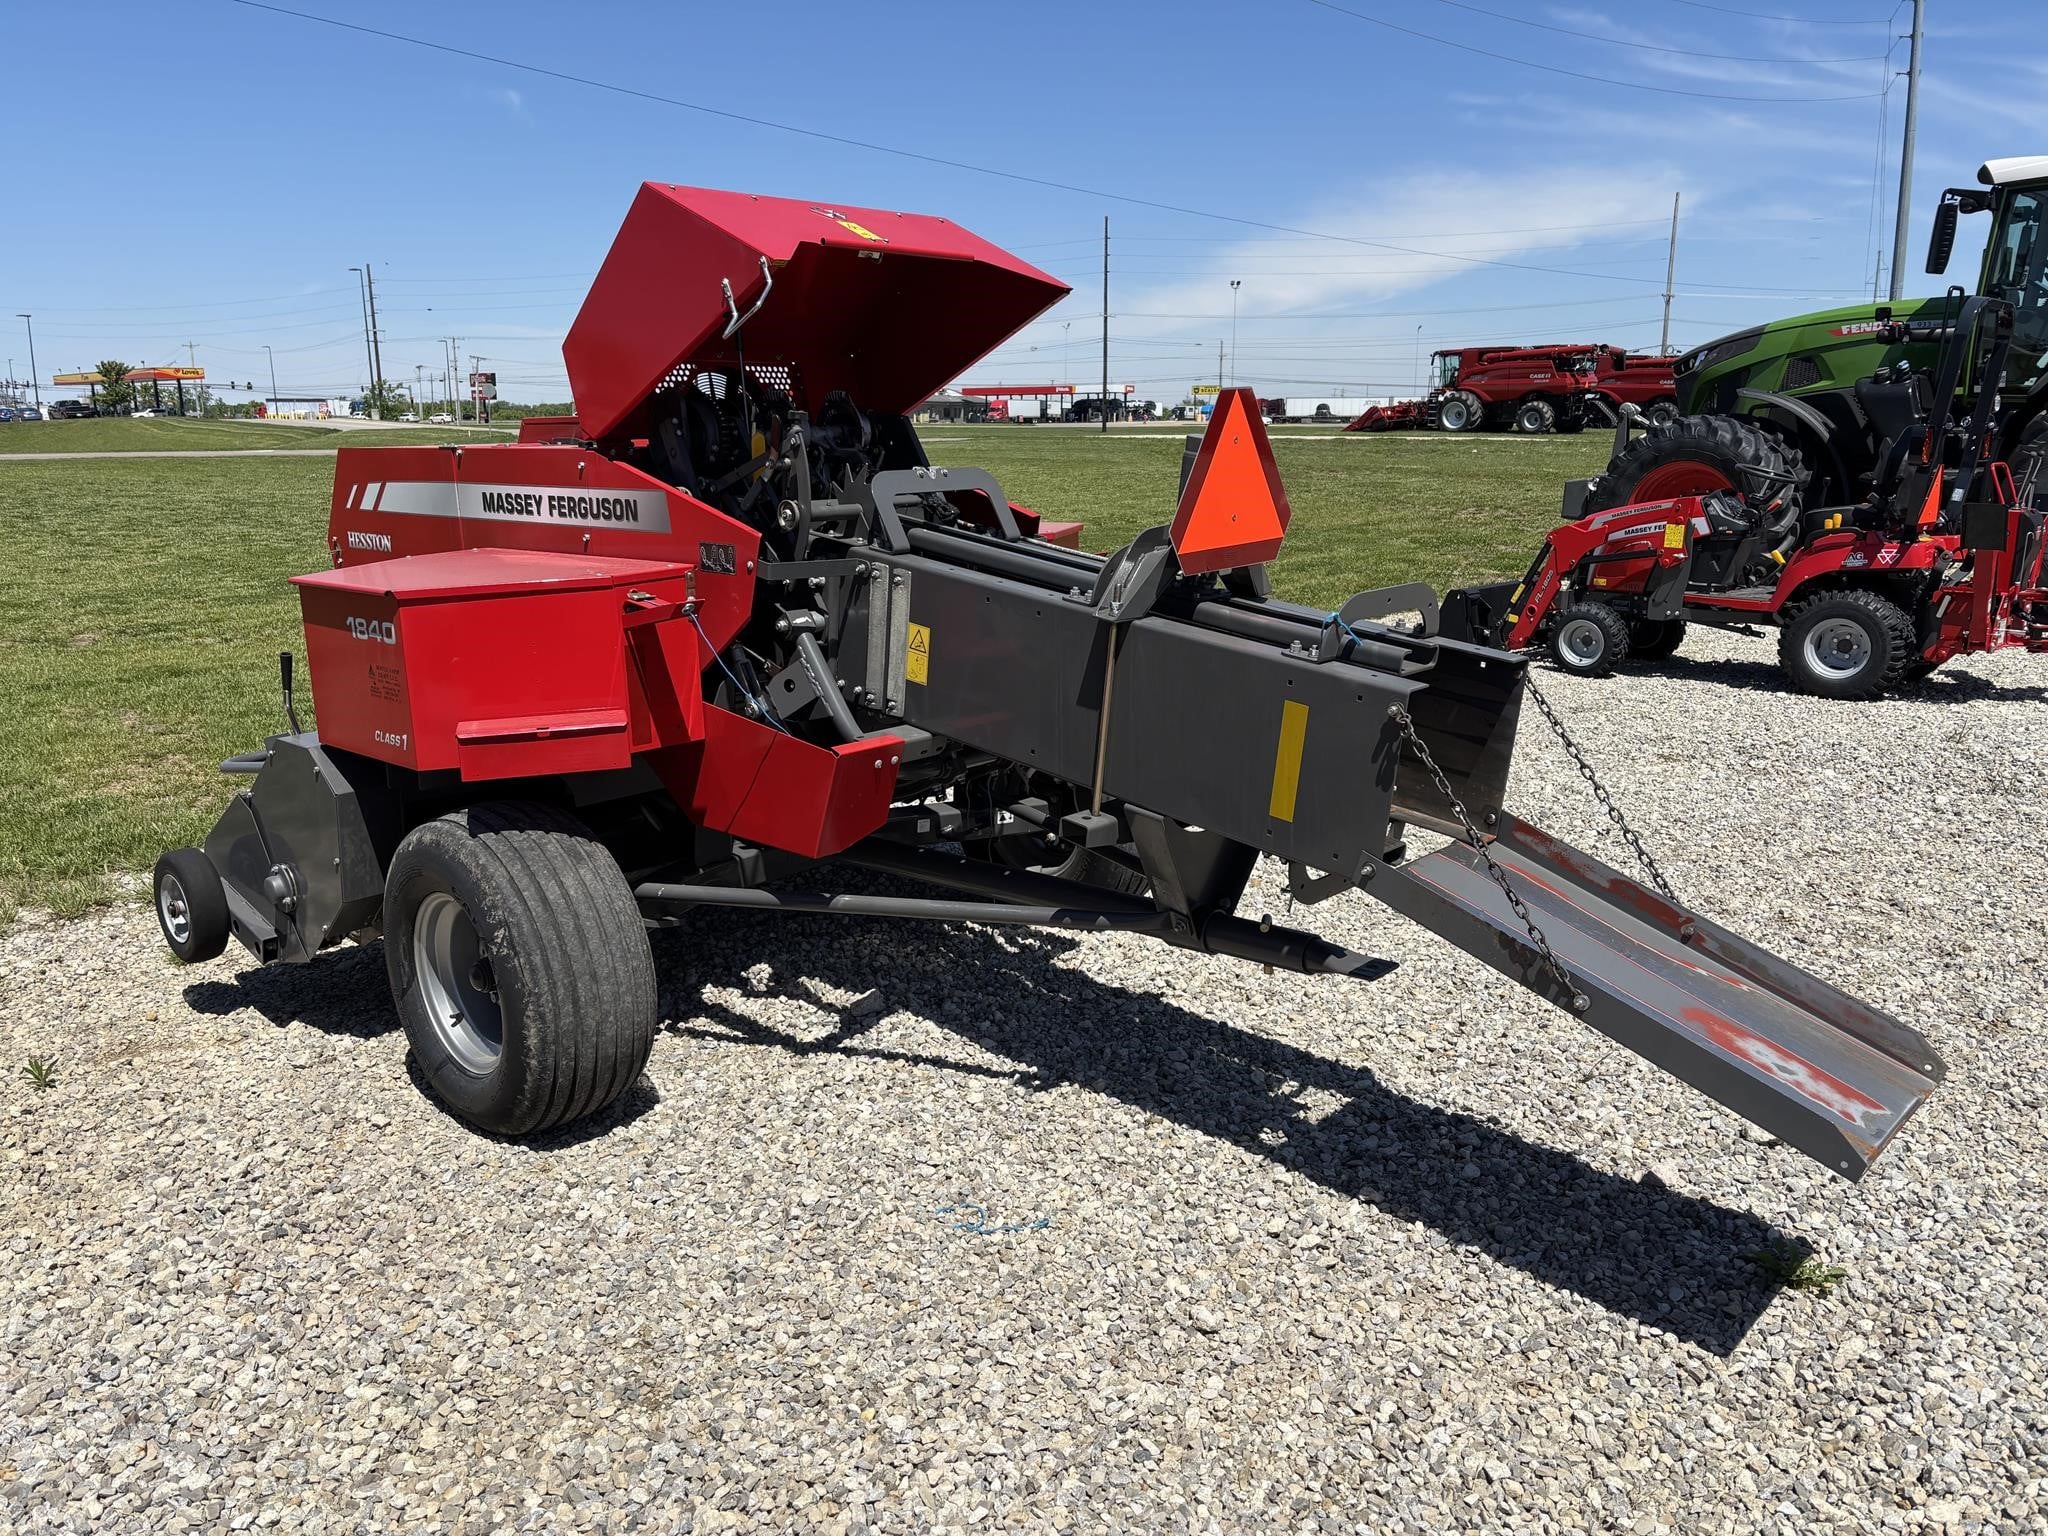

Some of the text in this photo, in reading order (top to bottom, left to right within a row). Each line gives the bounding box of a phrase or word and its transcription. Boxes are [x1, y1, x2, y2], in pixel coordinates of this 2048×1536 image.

[481, 491, 639, 522] MASSEY FERGUSON
[1611, 504, 1662, 518] MASSEY FERGUSON
[347, 530, 392, 552] HESSTON
[1624, 526, 1653, 536] MASSEY
[1846, 551, 1864, 561] AG
[346, 616, 397, 645] 1840
[375, 730, 407, 751] CLASS 1
